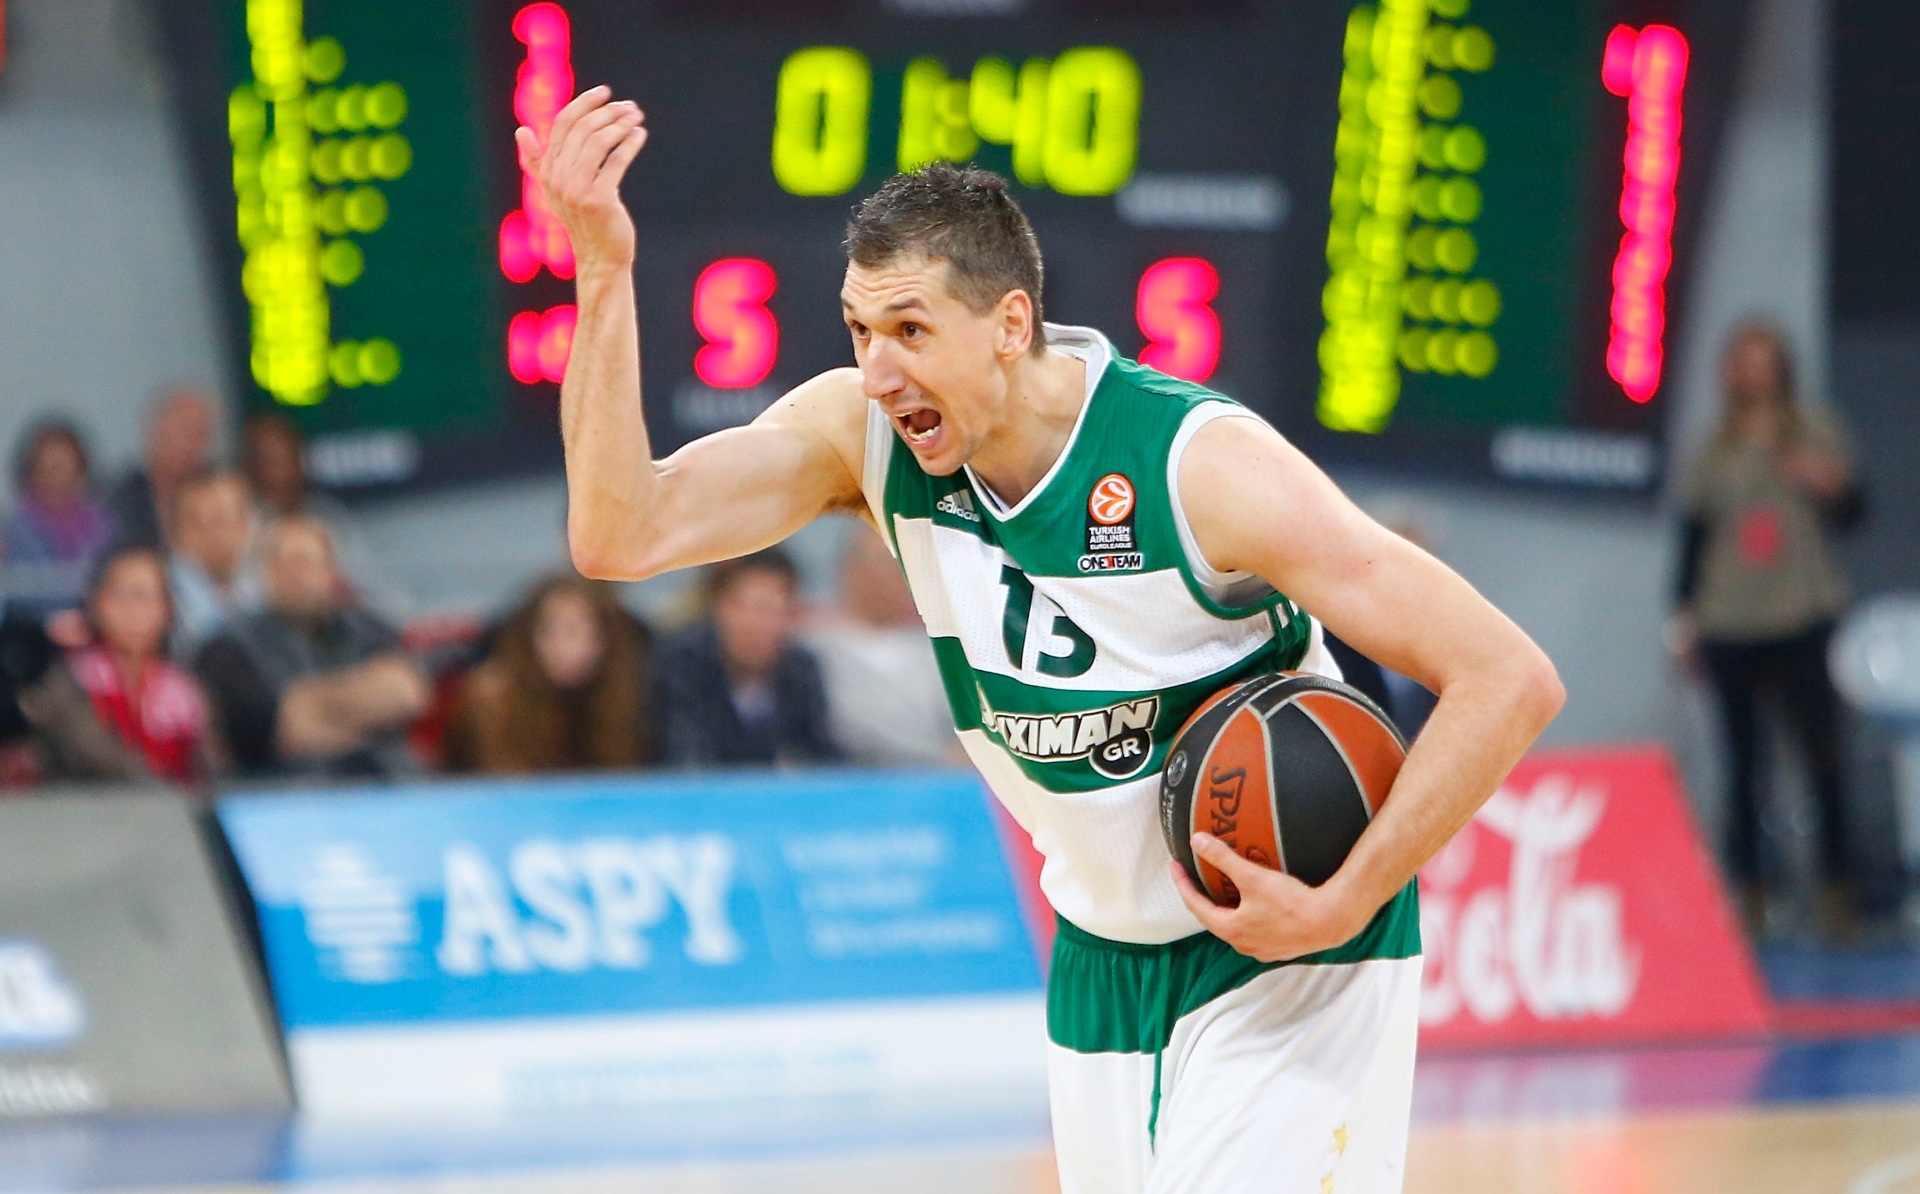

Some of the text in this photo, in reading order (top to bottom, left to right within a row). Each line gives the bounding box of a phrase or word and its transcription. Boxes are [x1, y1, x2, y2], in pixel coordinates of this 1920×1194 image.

[693, 258, 778, 388] 5
[1136, 257, 1221, 384] 5
[936, 500, 980, 523] adidas
[1088, 526, 1130, 535] TURKISH
[1089, 534, 1130, 544] AIRLINES
[1102, 737, 1142, 762] GR
[1210, 766, 1247, 850] SPA
[438, 832, 743, 975] ASPY
